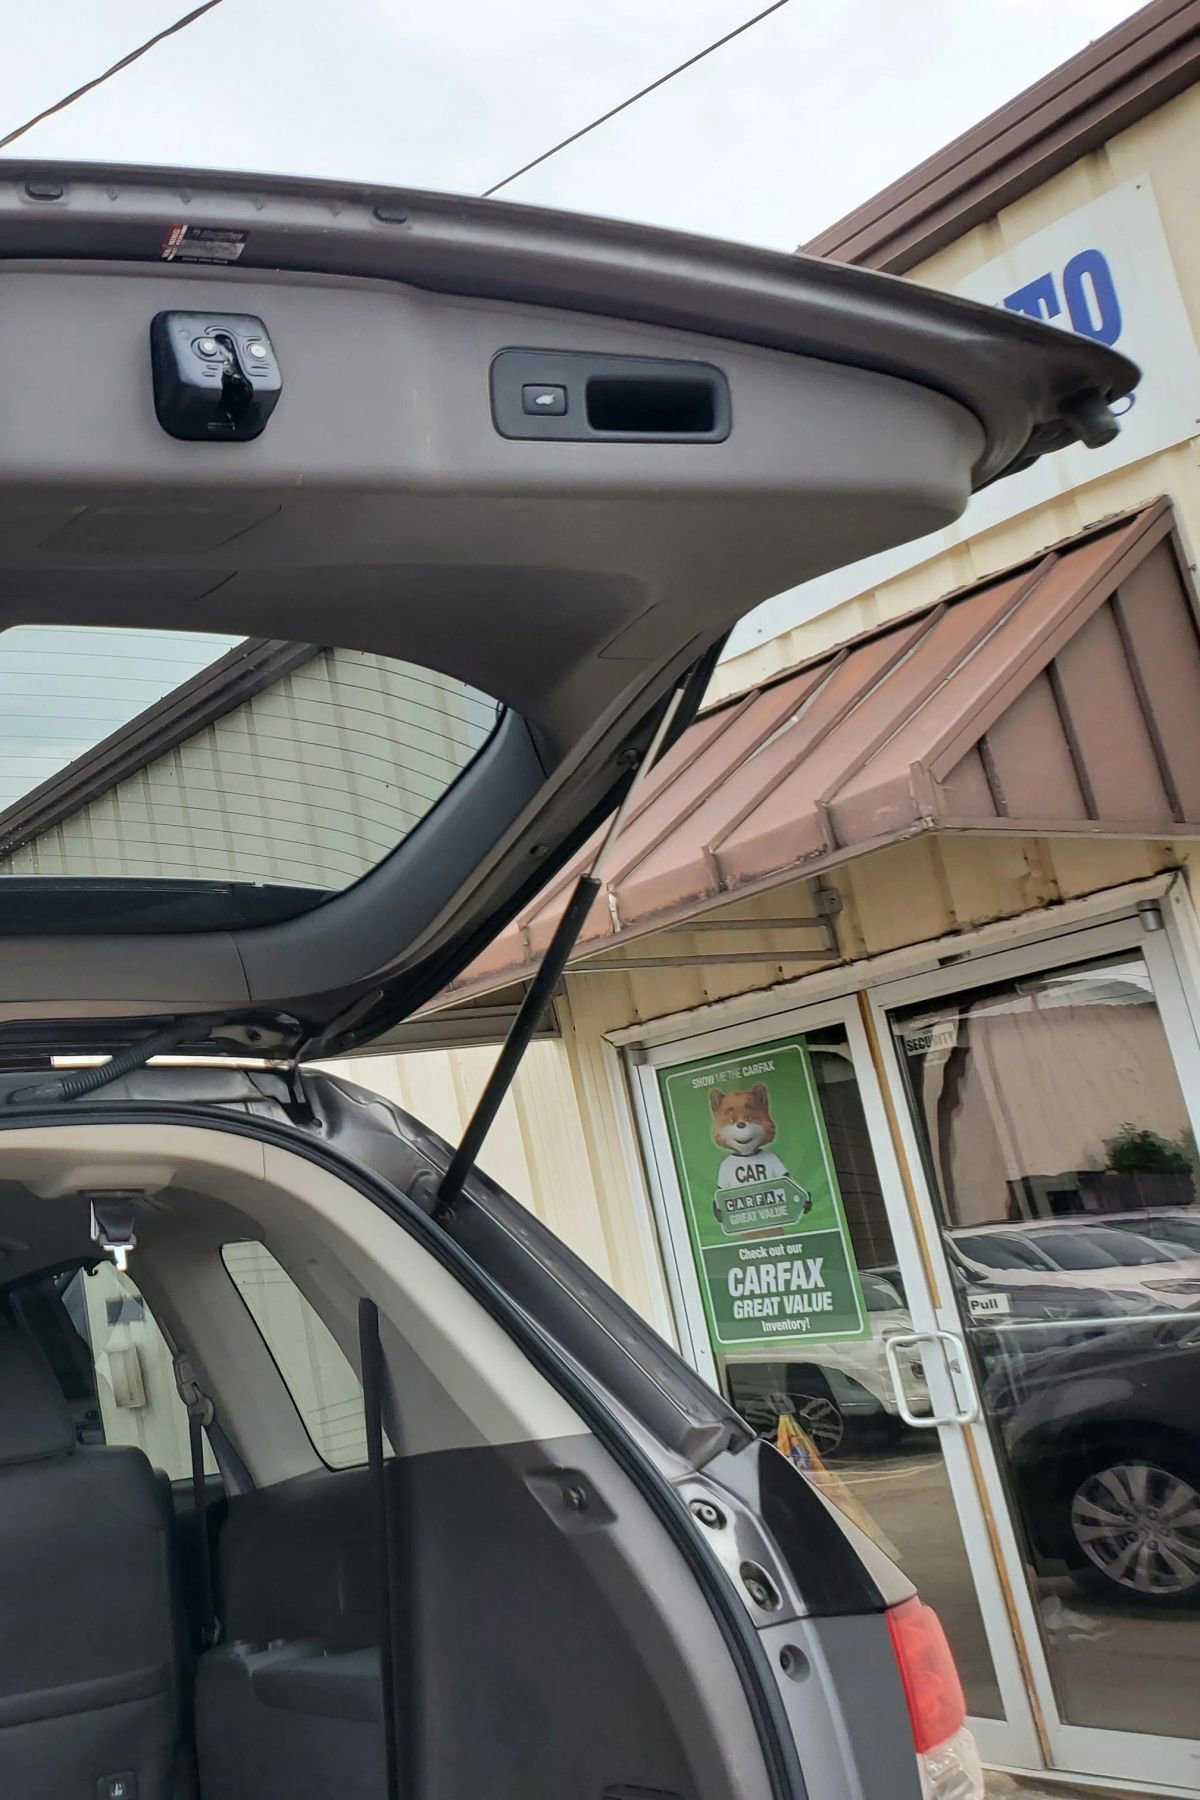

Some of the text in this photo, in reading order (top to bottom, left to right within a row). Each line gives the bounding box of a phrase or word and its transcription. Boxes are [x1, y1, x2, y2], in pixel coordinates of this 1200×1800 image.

[906, 1030, 954, 1052] SECURITY
[692, 1074, 715, 1089] SHOW
[728, 1067, 743, 1080] THE
[742, 1060, 775, 1077] CARFAX
[735, 1163, 767, 1183] CAR
[726, 1191, 784, 1212] CARFAX
[730, 1205, 789, 1225] GREAT VALUE
[739, 1243, 803, 1260] Check out our
[728, 1257, 825, 1297] CARFAX
[733, 1291, 833, 1319] GREAT VALUE
[971, 1299, 999, 1312] Pull
[761, 1318, 810, 1333] Inventory!
